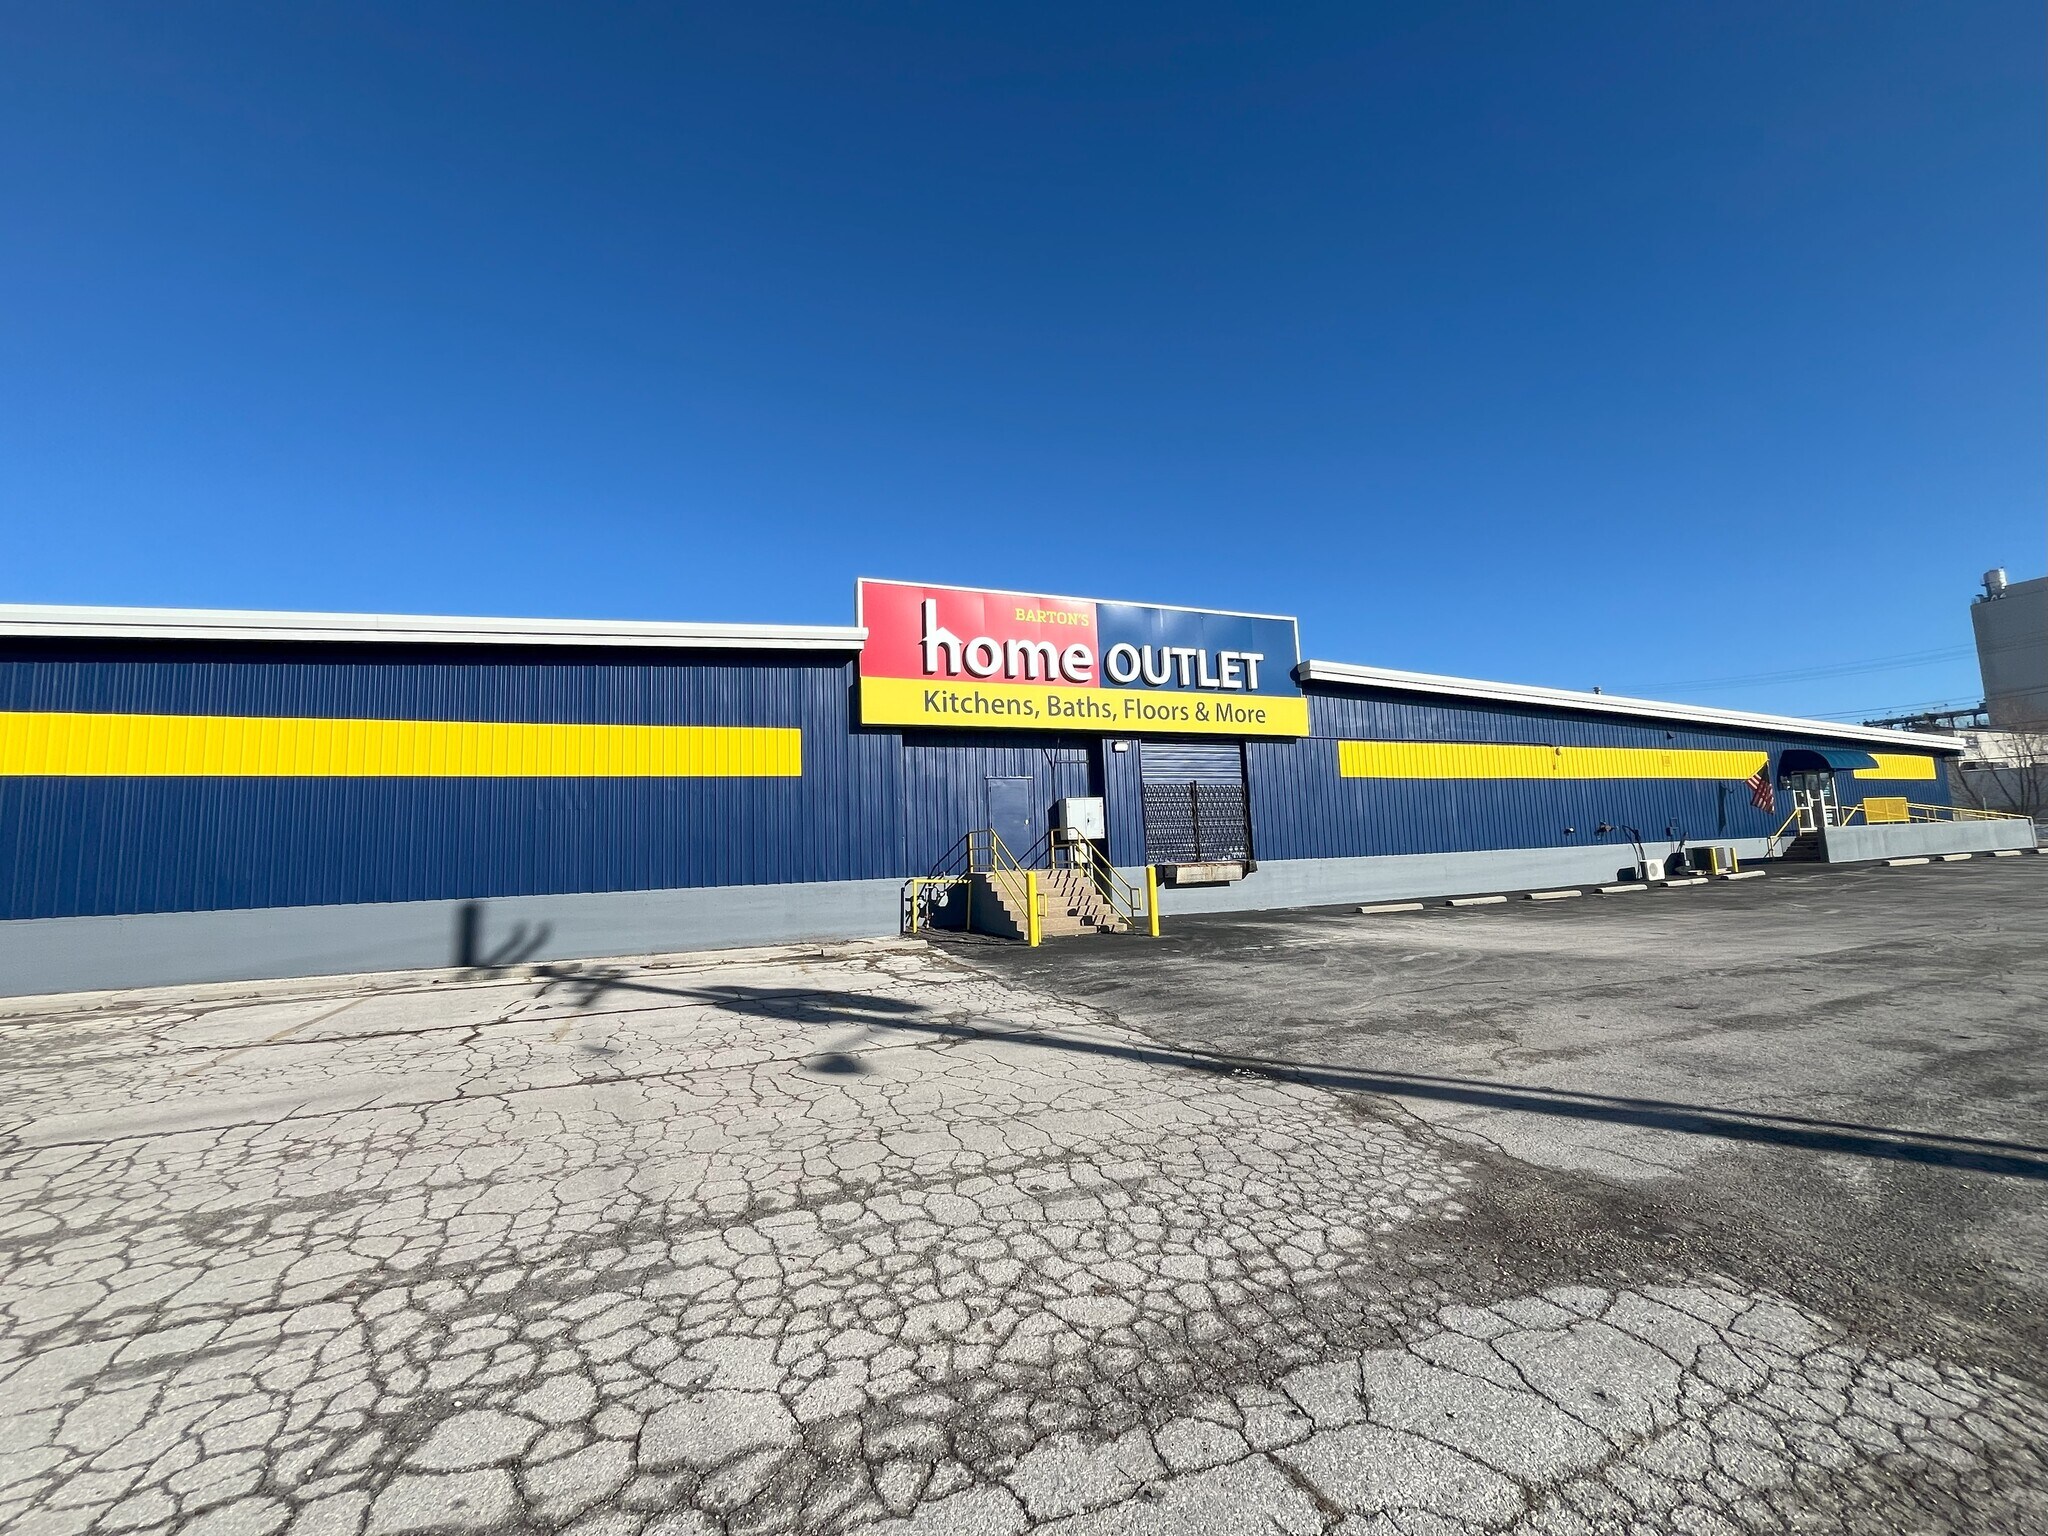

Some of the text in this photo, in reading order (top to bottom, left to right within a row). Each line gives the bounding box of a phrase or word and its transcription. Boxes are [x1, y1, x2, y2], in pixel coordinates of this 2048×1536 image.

[1015, 607, 1089, 627] BARTON'S
[918, 598, 1265, 691] home OUTLET
[924, 690, 1266, 724] Kitchens, Baths, Floors & More
